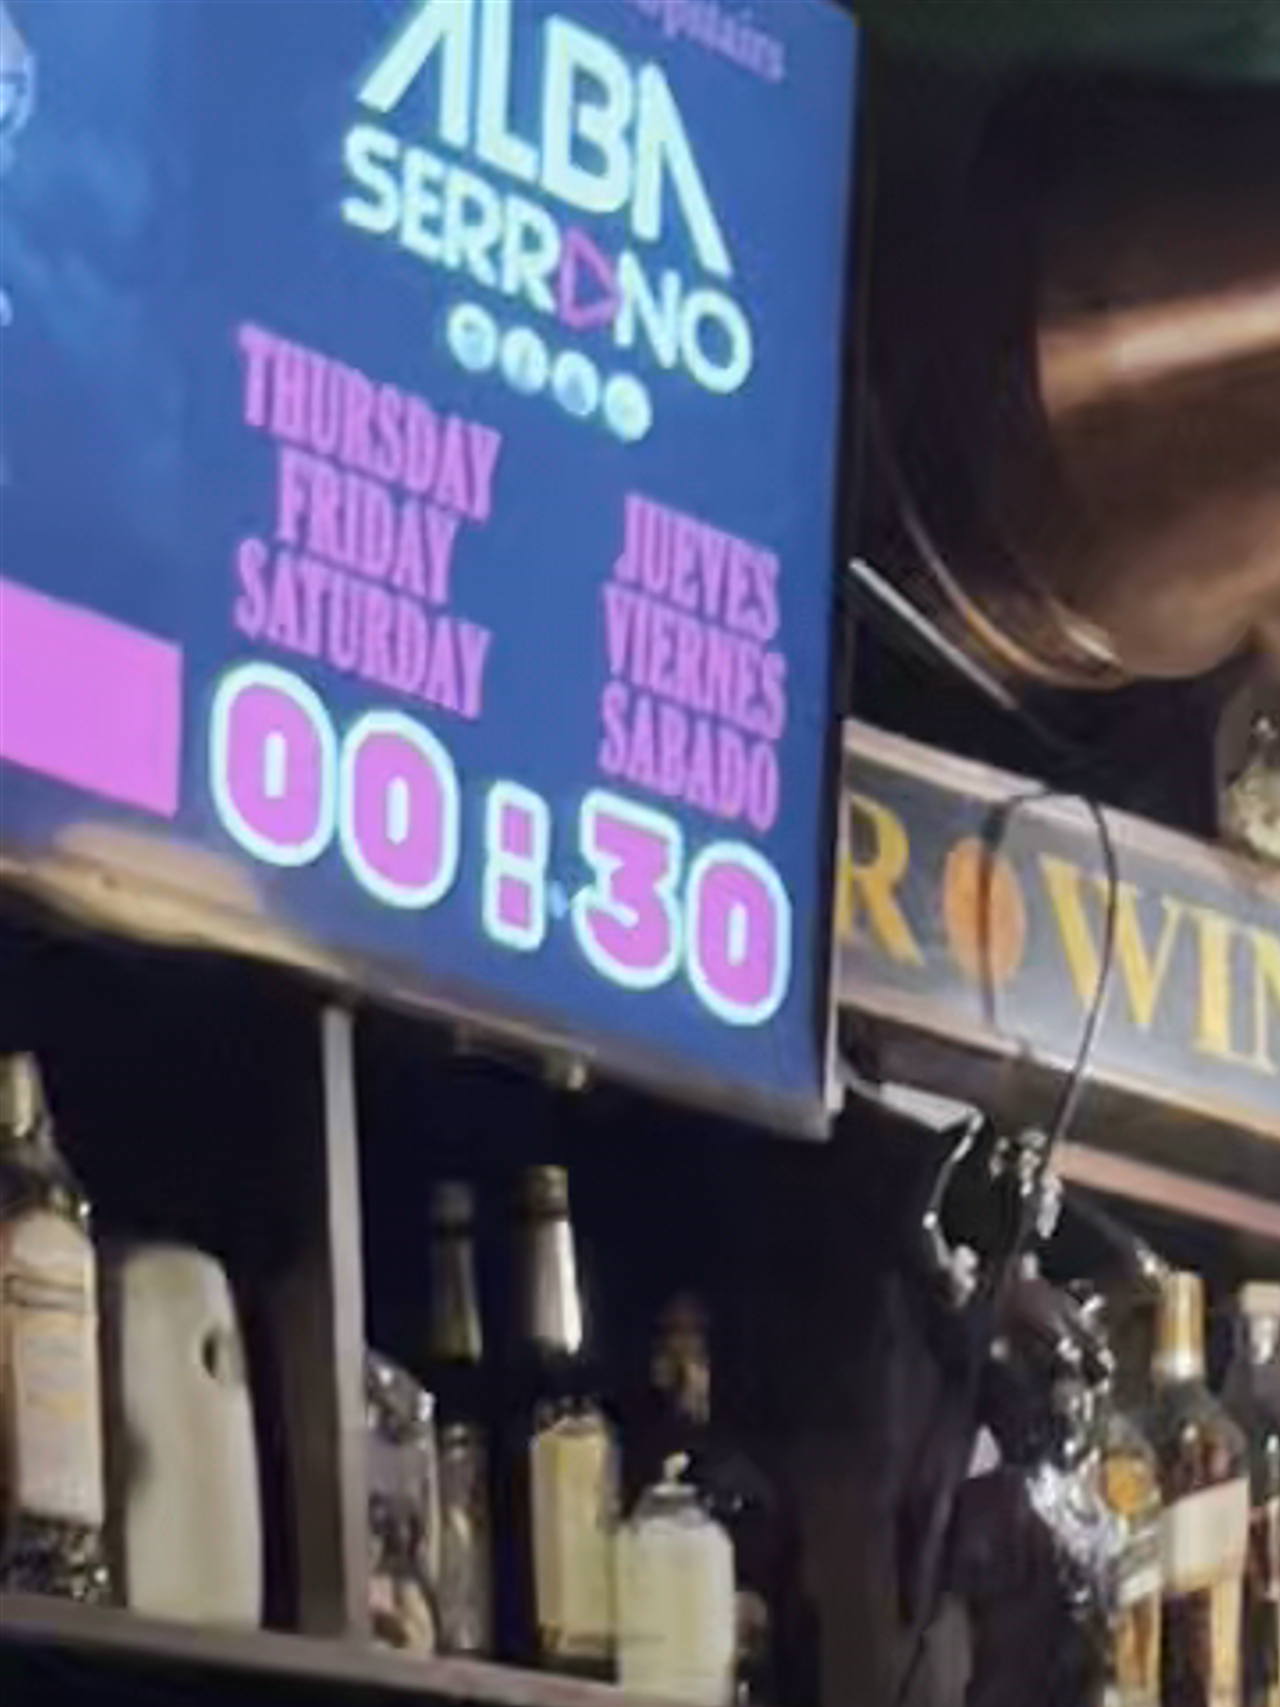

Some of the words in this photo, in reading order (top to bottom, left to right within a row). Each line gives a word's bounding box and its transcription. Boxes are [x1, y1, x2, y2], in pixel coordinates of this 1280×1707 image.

[357, 0, 732, 278] ALBA
[238, 322, 500, 522] THURSDAY
[277, 447, 456, 604] FRIDAY
[616, 492, 779, 643] JUEVES
[235, 539, 490, 719] SATURDAY
[601, 582, 786, 739] VIERNES
[600, 683, 778, 834] SABADO
[210, 661, 790, 1025] 00:30
